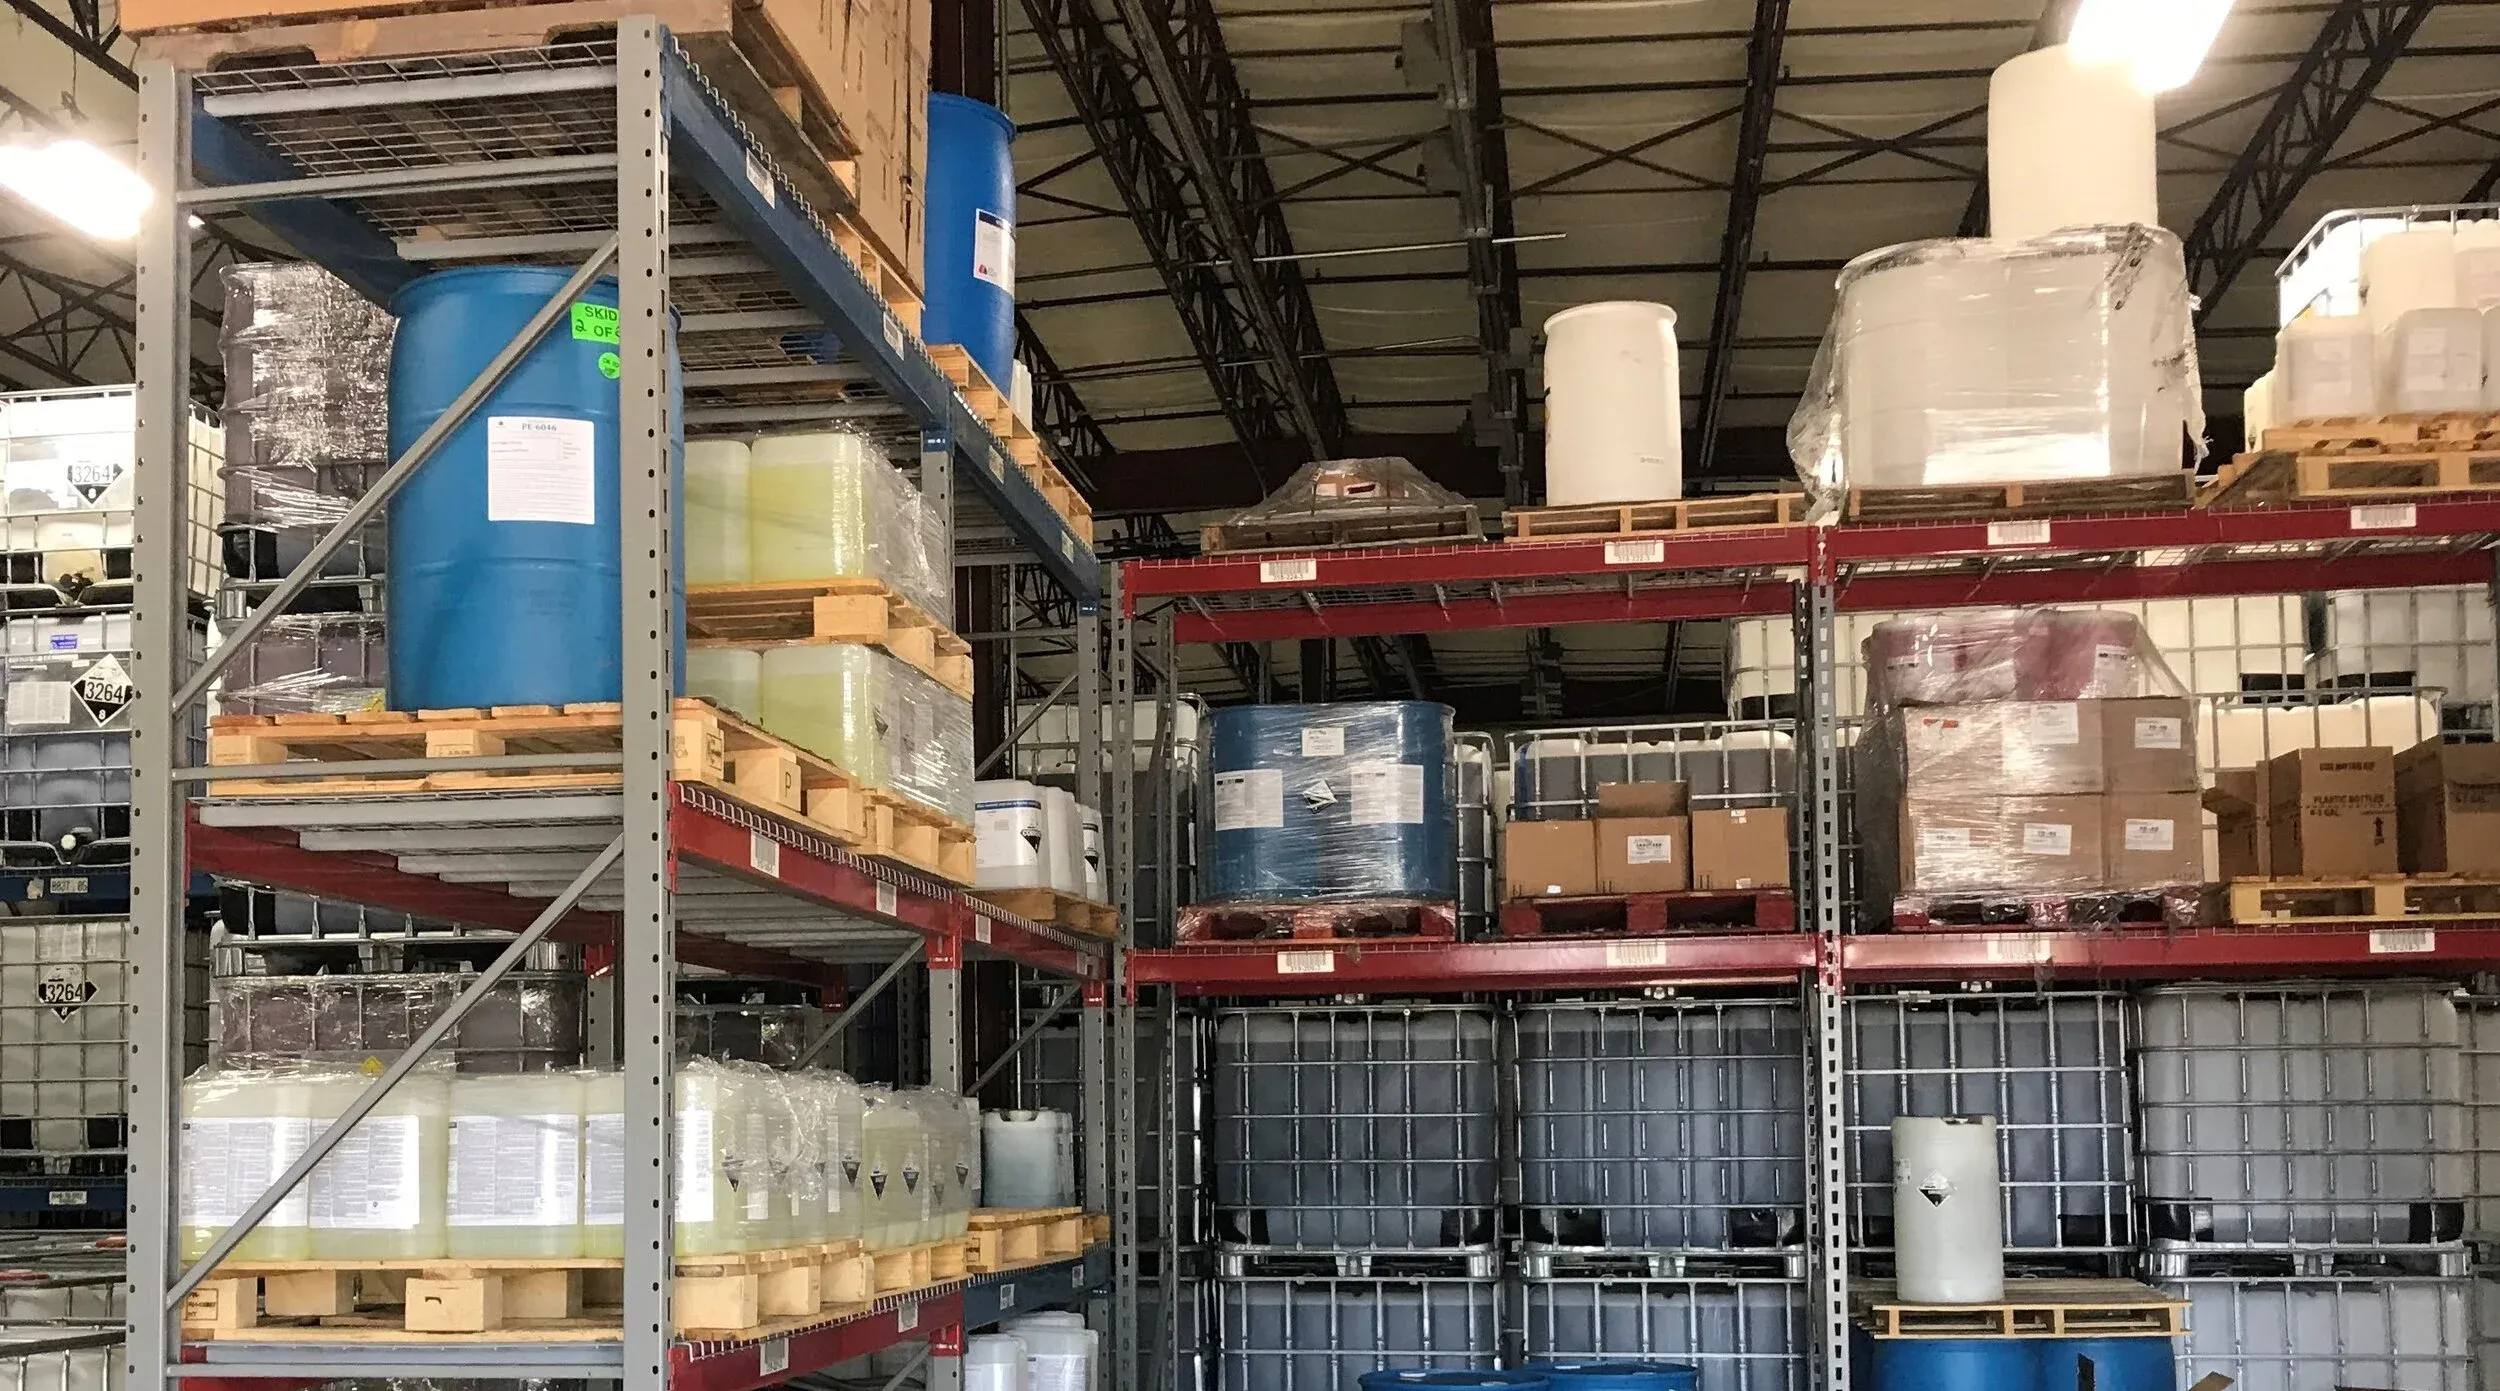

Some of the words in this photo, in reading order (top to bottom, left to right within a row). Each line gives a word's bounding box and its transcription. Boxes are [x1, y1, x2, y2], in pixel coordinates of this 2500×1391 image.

[585, 306, 618, 321] SKID
[575, 319, 587, 332] 2
[594, 325, 612, 337] OF
[74, 465, 110, 482] 3264
[86, 681, 123, 703] 3264
[98, 709, 107, 720] 8
[47, 983, 82, 1001] 3264
